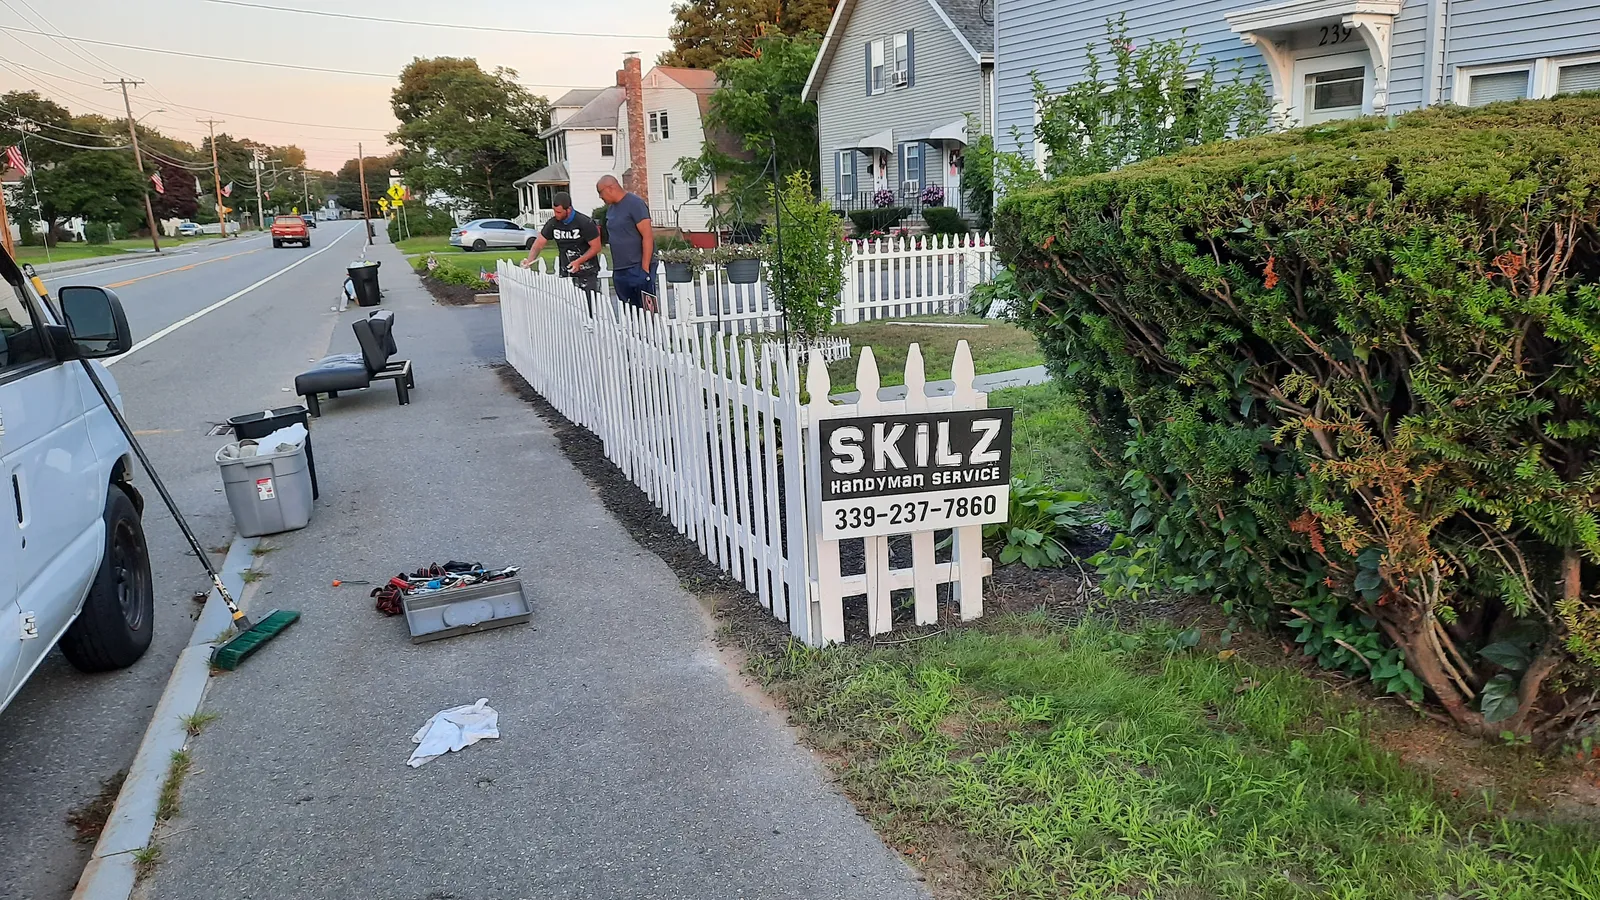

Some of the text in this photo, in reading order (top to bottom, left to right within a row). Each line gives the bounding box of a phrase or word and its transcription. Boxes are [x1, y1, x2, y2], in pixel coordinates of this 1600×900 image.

[1319, 24, 1352, 46] 239
[932, 467, 1000, 485] SERVICE
[835, 494, 996, 530] 339-237-7860
